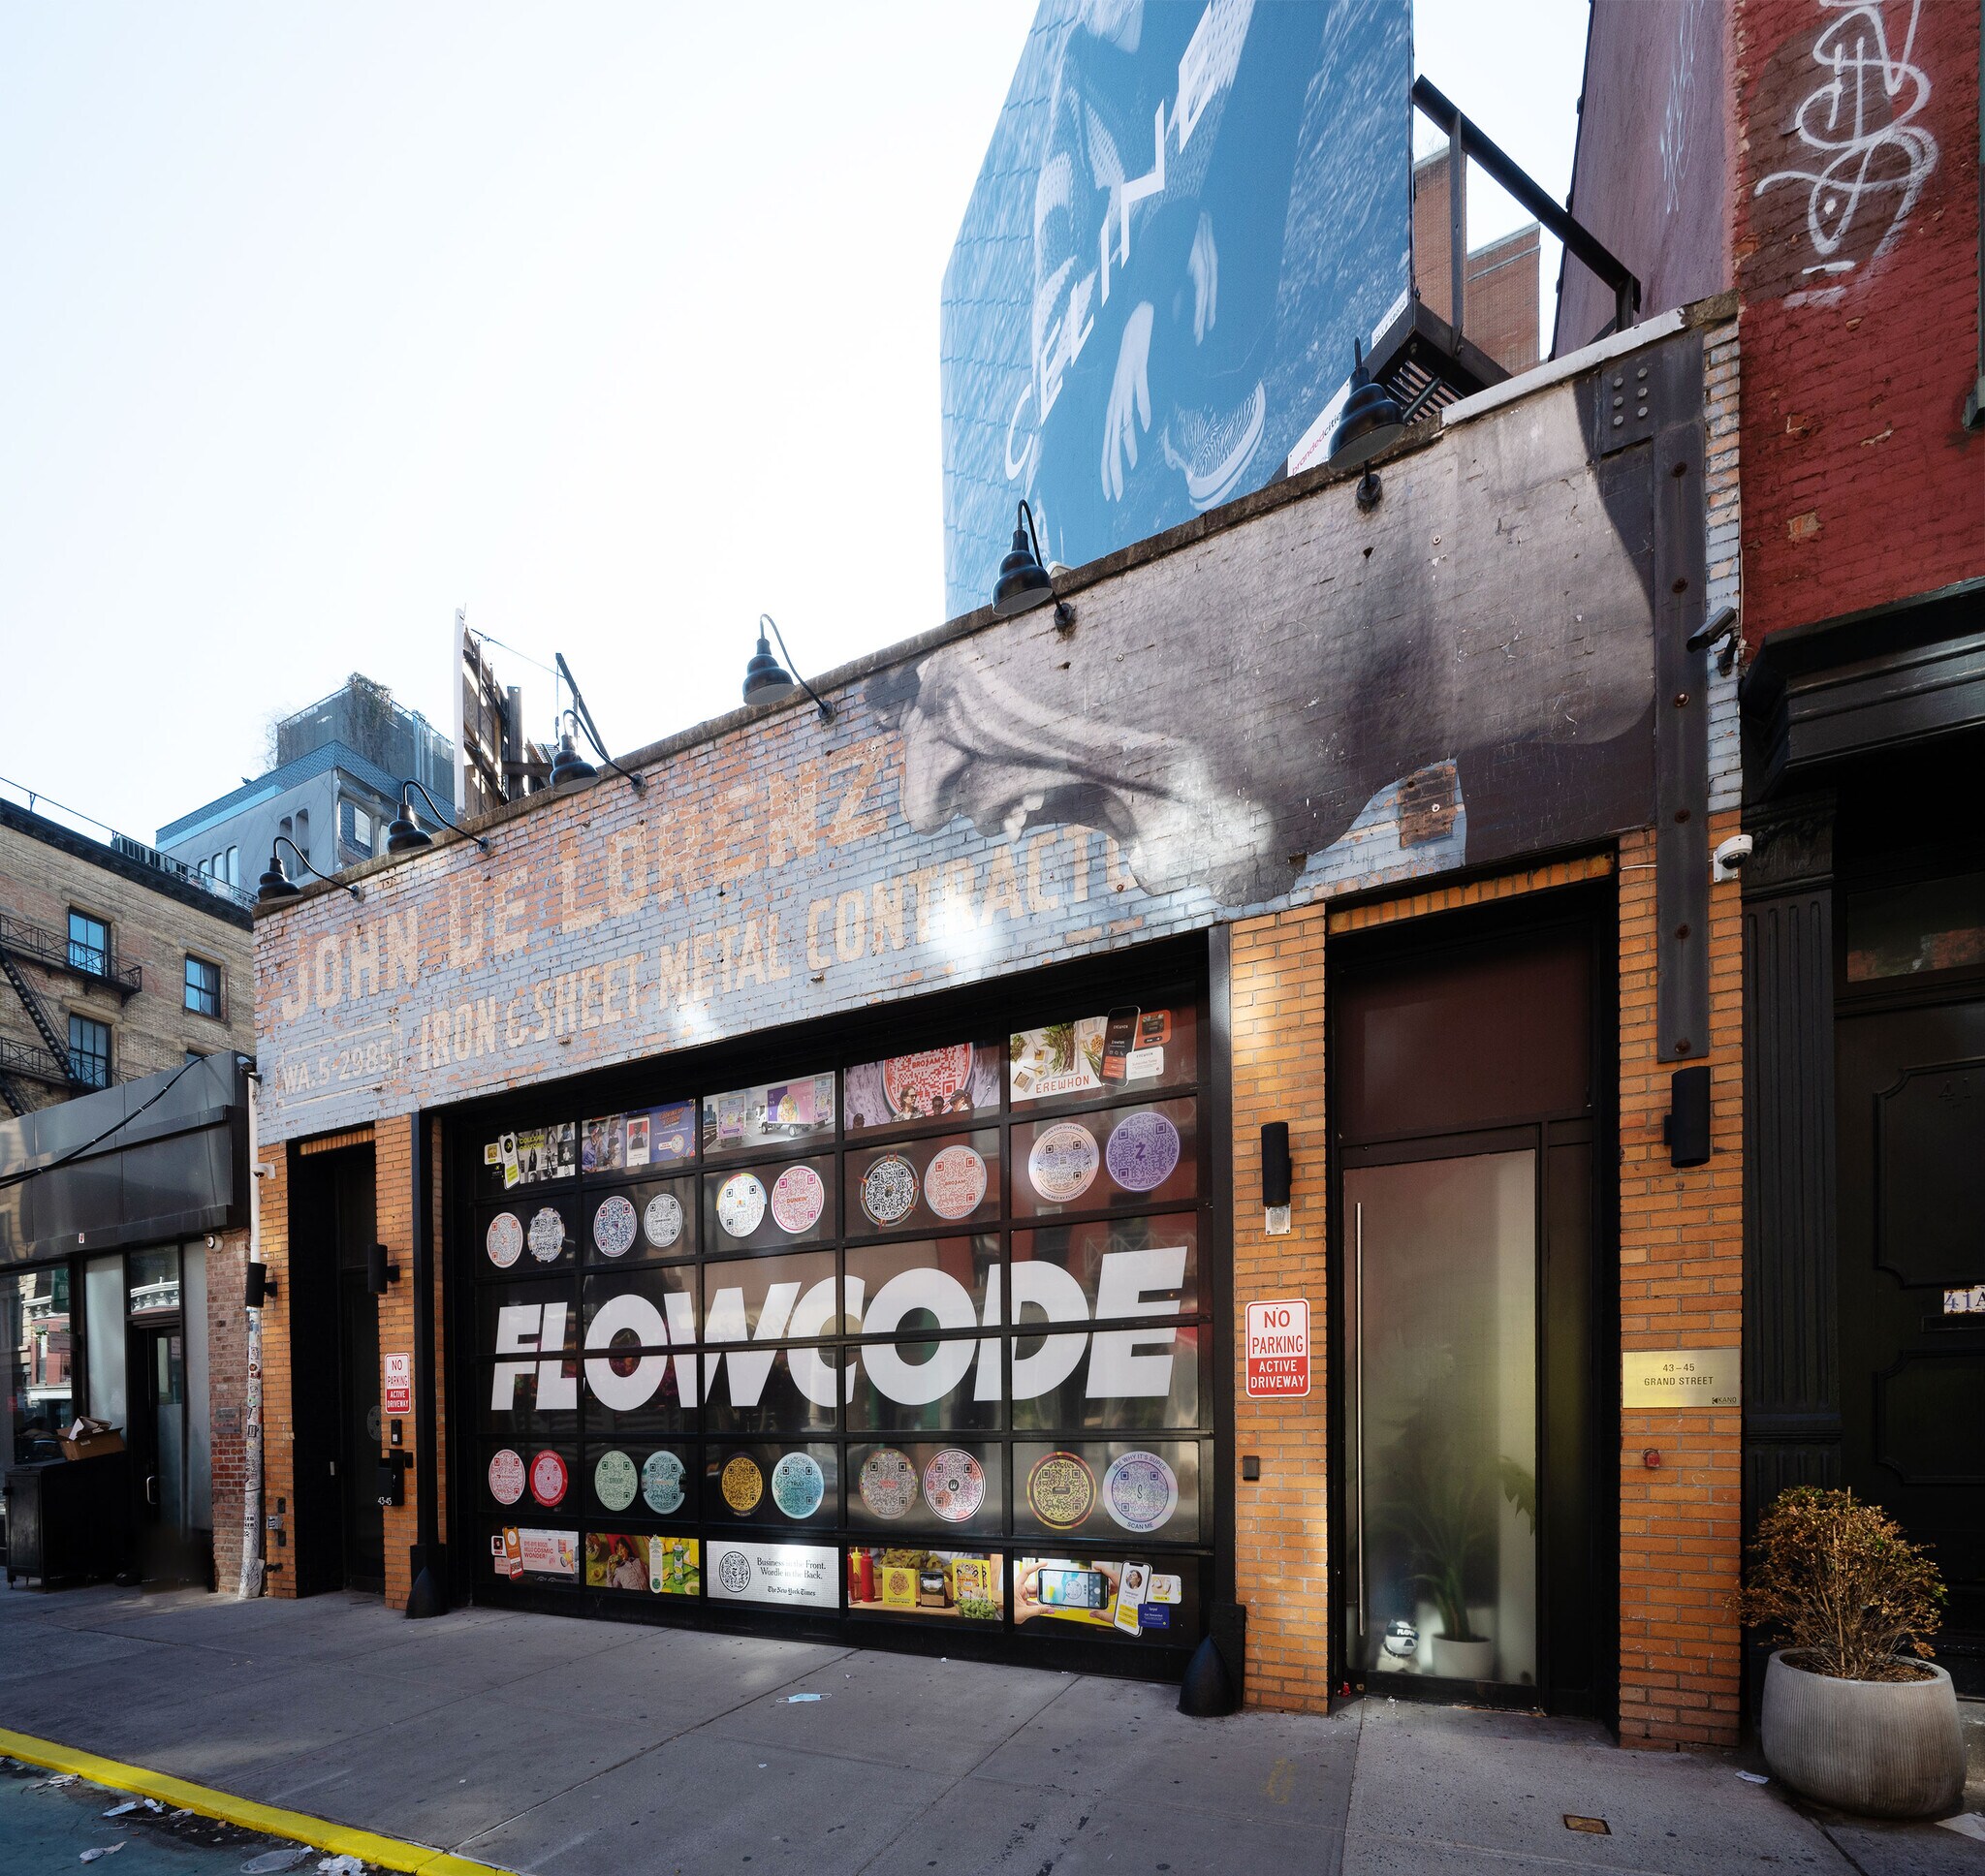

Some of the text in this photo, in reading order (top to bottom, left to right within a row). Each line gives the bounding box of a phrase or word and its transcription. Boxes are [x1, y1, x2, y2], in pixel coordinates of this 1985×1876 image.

[282, 734, 906, 1019] JOHN DE LORENZ
[418, 996, 496, 1072] IRON
[534, 952, 646, 1042] SHEET
[658, 912, 791, 1011] METAL
[1035, 1075, 1090, 1094] EREWHON
[1264, 1309, 1291, 1329] NO
[491, 1246, 1187, 1411] FLOWCODE
[1252, 1334, 1304, 1355] PARKING
[392, 1359, 403, 1371] NO
[1258, 1360, 1298, 1373] ACTIVE
[387, 1374, 408, 1387] PARKING
[1250, 1374, 1306, 1389] DRIVEWAY
[1644, 1376, 1714, 1387] GRAND STREET
[390, 1390, 406, 1399] ACTIVE
[387, 1398, 409, 1409] DRIVEWAY
[1112, 1453, 1168, 1471] SEE WHY IT'S SUPER
[377, 1496, 393, 1506] 43-45
[1126, 1520, 1144, 1530] SCAN
[756, 1556, 785, 1567] Business
[805, 1559, 827, 1570] Front.
[760, 1566, 783, 1577] Wordle
[803, 1570, 823, 1579] Back.
[767, 1585, 776, 1594] The
[788, 1586, 801, 1595] York
[800, 1588, 816, 1597] Times
